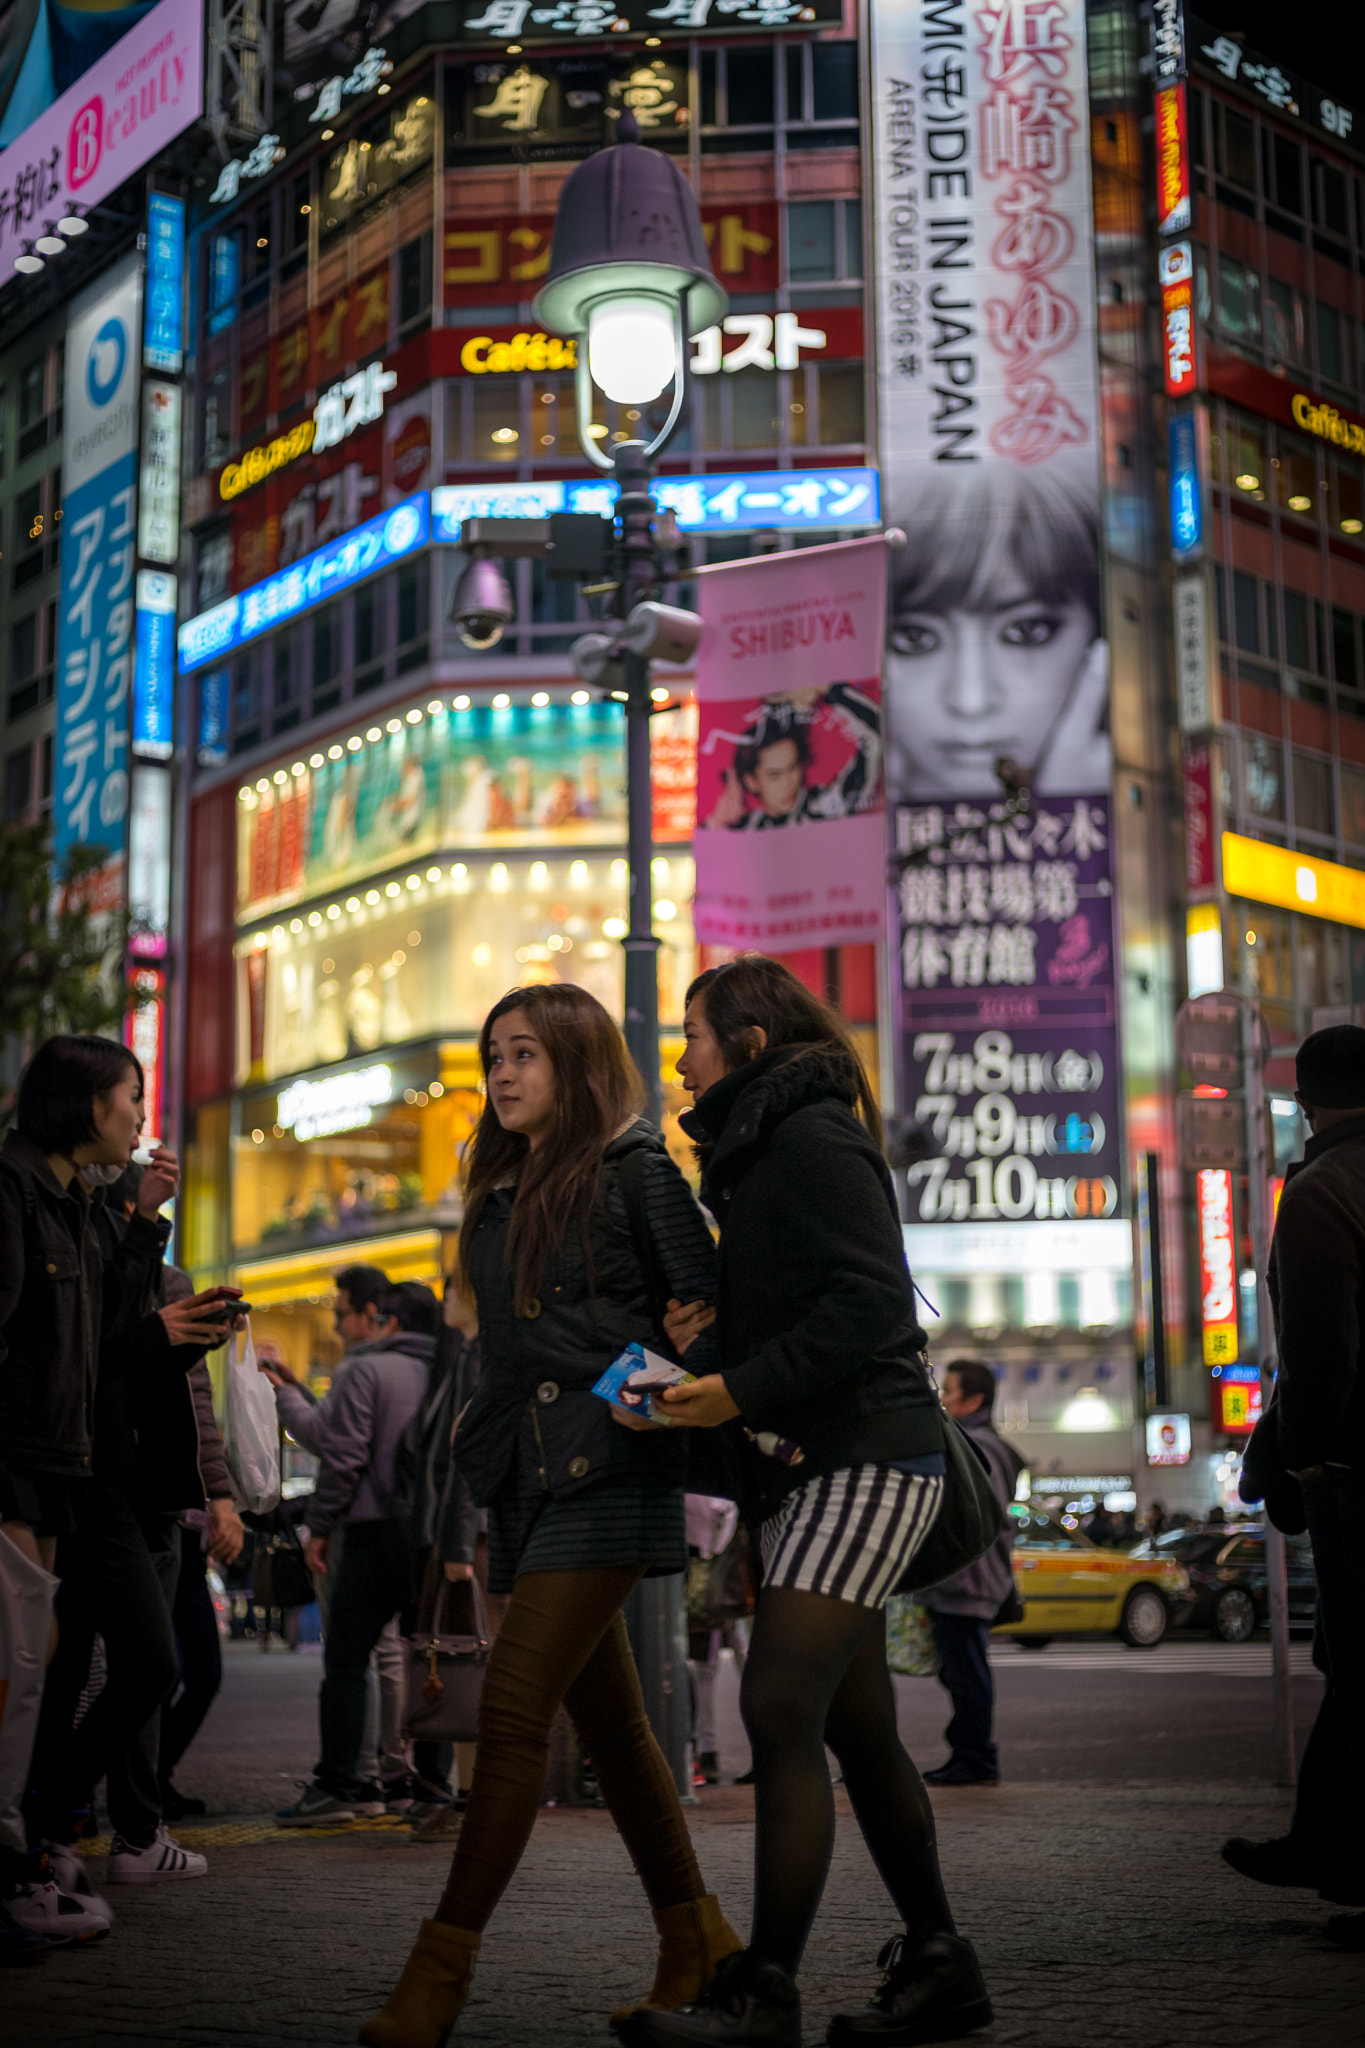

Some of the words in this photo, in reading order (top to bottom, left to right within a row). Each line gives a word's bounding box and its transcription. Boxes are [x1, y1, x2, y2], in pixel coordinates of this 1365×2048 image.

[68, 46, 190, 186] Beauty
[887, 78, 915, 180] ARENA
[1320, 99, 1353, 138] 9F
[443, 216, 773, 284] コント
[889, 186, 921, 274] TOUR
[925, 217, 973, 270] IN
[974, 0, 1089, 463] 浜崎あゆみ
[890, 279, 922, 354] 2016
[928, 283, 982, 463] JAPAN
[98, 485, 137, 828] コンタクトの
[730, 609, 857, 661] SHIBUYA
[62, 505, 106, 842] アイシティ
[902, 922, 1037, 990] 体育館
[912, 1030, 1104, 1096] 7月8日(金)
[914, 1091, 1106, 1159] 7月9日(土)
[906, 1153, 1118, 1222] 7月10日(日)
